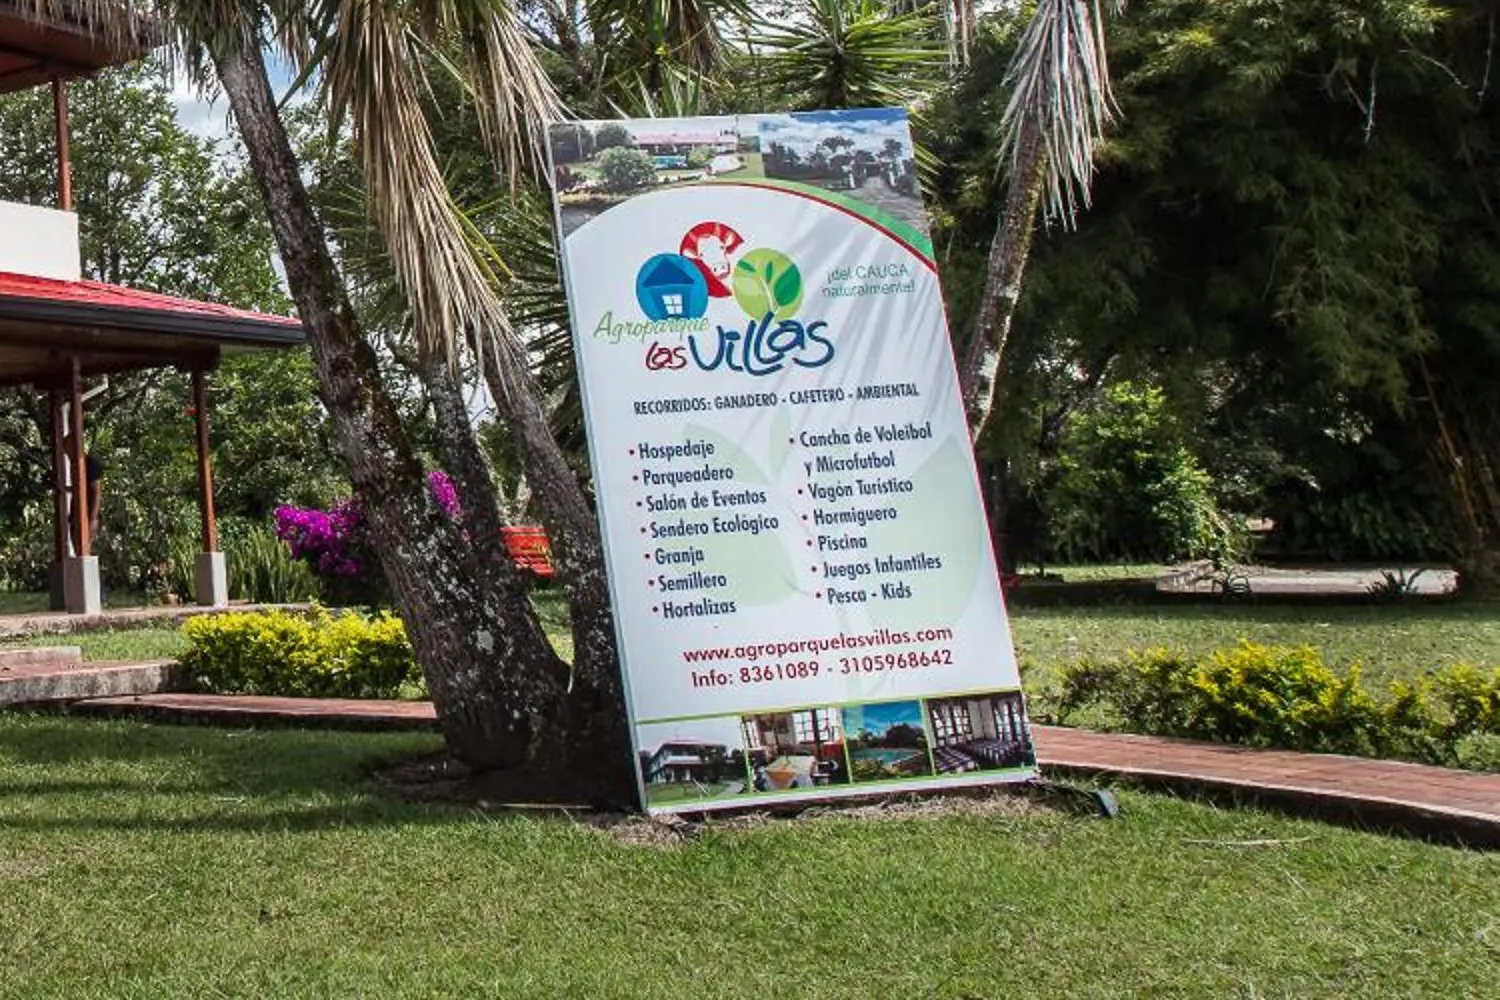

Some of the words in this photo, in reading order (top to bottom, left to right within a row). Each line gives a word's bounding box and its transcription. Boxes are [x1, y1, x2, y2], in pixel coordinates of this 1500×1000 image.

[855, 263, 908, 279] CAUCA
[821, 279, 916, 297] naturalmente!
[593, 311, 709, 343] Agroparque
[634, 398, 712, 415] RECORRIDOS:
[714, 393, 778, 409] GANADERO
[789, 388, 845, 404] CAFETERO
[856, 383, 920, 400] AMBIENTAL
[800, 428, 851, 447] Cancha
[855, 426, 872, 444] de
[873, 421, 933, 441] Voleibol
[638, 439, 715, 462] Hospedaje
[804, 461, 812, 477] y
[816, 450, 896, 473] Microfutbol
[642, 464, 734, 488] Parqueadero
[646, 493, 687, 512] Salón
[691, 491, 709, 509] de
[712, 489, 767, 507] Eventos
[807, 481, 853, 502] Vagón
[650, 518, 709, 539] Sendero
[712, 514, 779, 535] Ecológico
[813, 507, 897, 526] Hormiguero
[817, 534, 868, 551] Piscina
[655, 546, 705, 566] Granja
[823, 561, 871, 580] Juegos
[874, 552, 942, 574] Infantiles
[658, 571, 727, 592] Semillero
[827, 587, 867, 605] Pesca
[881, 581, 912, 600] Kids
[663, 597, 736, 619] Hortalizas
[683, 628, 953, 662] www.agroparquelasvillas.com
[692, 669, 733, 687] Info:
[739, 661, 819, 683] 8361089
[839, 649, 953, 675] 3105968642
